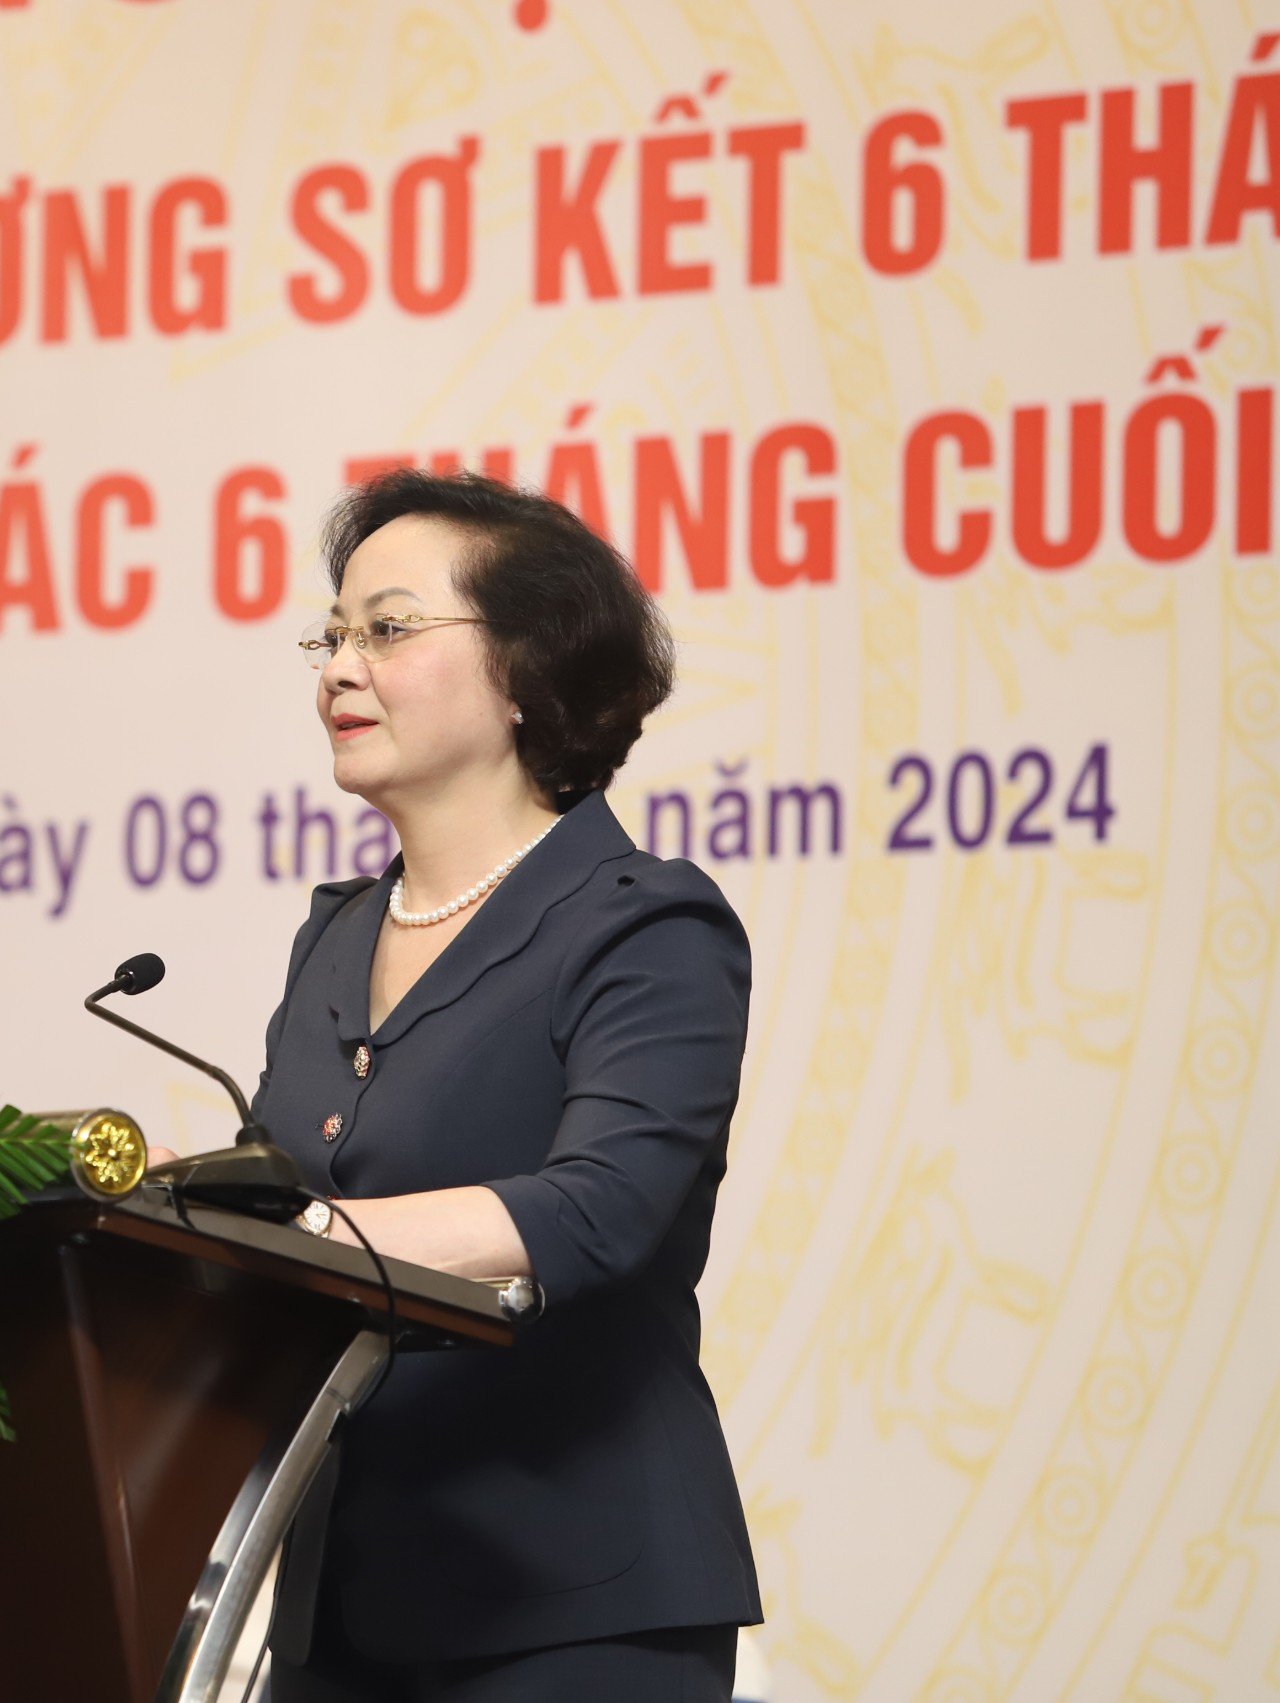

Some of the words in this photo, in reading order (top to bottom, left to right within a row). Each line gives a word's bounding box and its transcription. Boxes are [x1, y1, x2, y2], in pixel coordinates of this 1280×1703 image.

[288, 135, 481, 325] SƠ
[533, 72, 806, 306] KẾT
[861, 110, 946, 278] 6
[213, 466, 288, 623] 6
[901, 325, 1275, 579] CUỐI
[124, 794, 221, 888] 08
[646, 762, 843, 863] năm
[886, 741, 1117, 853] 2024
